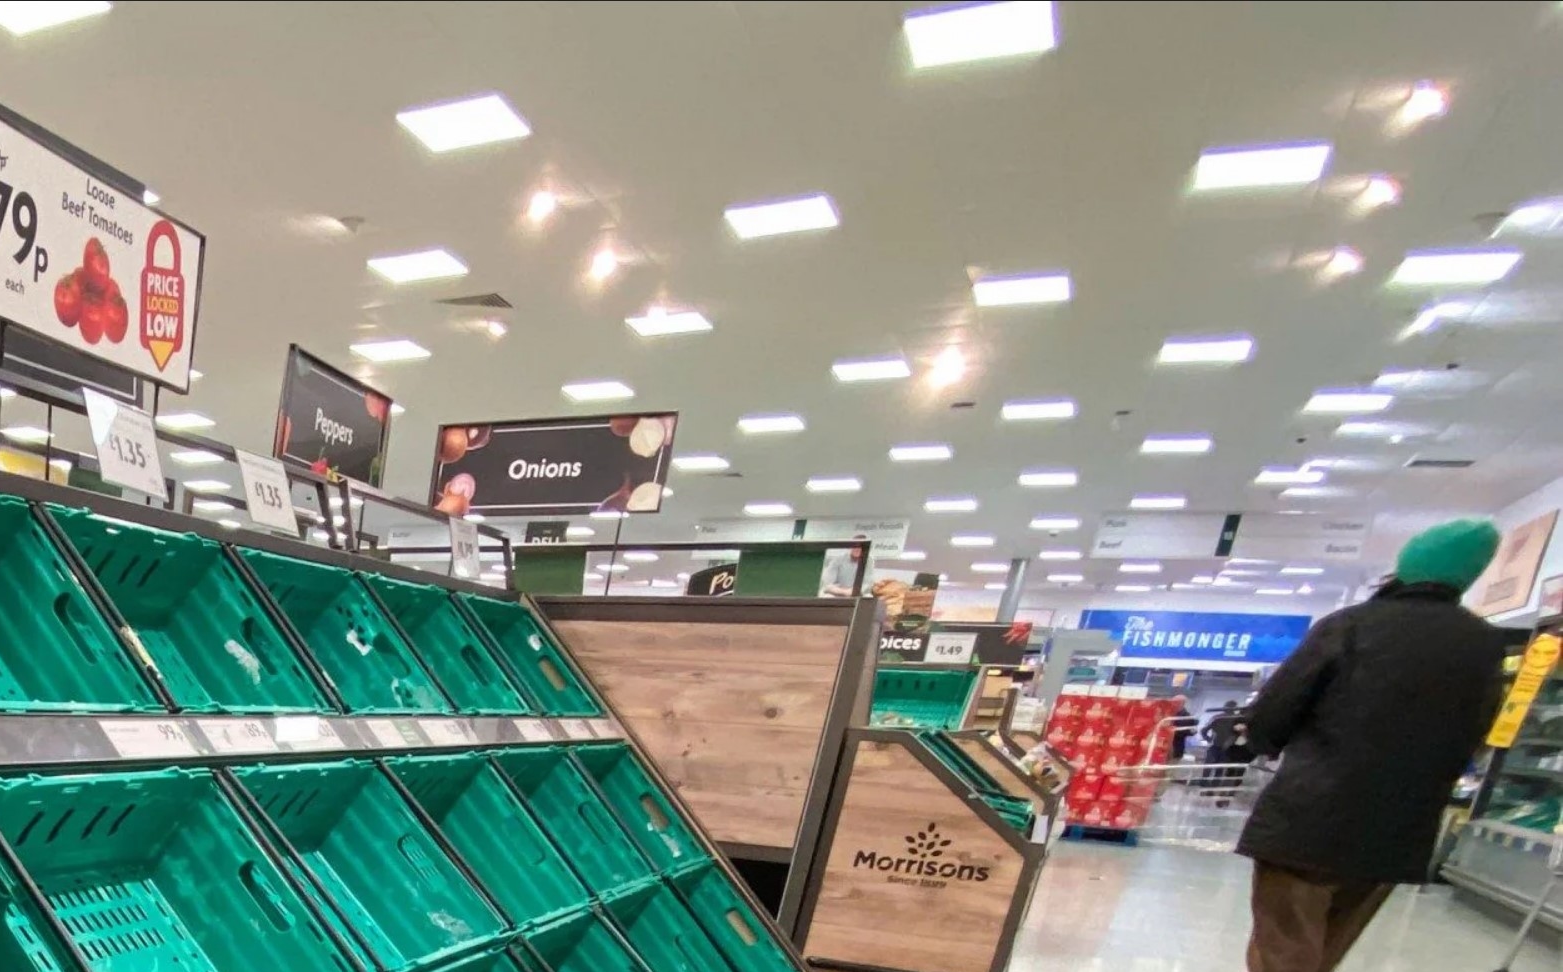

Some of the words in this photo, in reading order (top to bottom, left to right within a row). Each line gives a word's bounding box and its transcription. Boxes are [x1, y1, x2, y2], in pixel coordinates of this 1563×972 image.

[86, 177, 115, 209] Loose
[61, 191, 86, 219] Beef
[88, 205, 133, 245] Tomatoes
[5, 278, 25, 295] each
[147, 272, 179, 297] PRICE
[147, 295, 179, 314] LOCKED
[147, 312, 179, 339] LOW
[315, 406, 353, 446] Peppers
[508, 458, 582, 480] Onions
[1125, 616, 1154, 630] The
[1122, 630, 1251, 650] FISHMONGER
[853, 850, 990, 881] Morrisons
